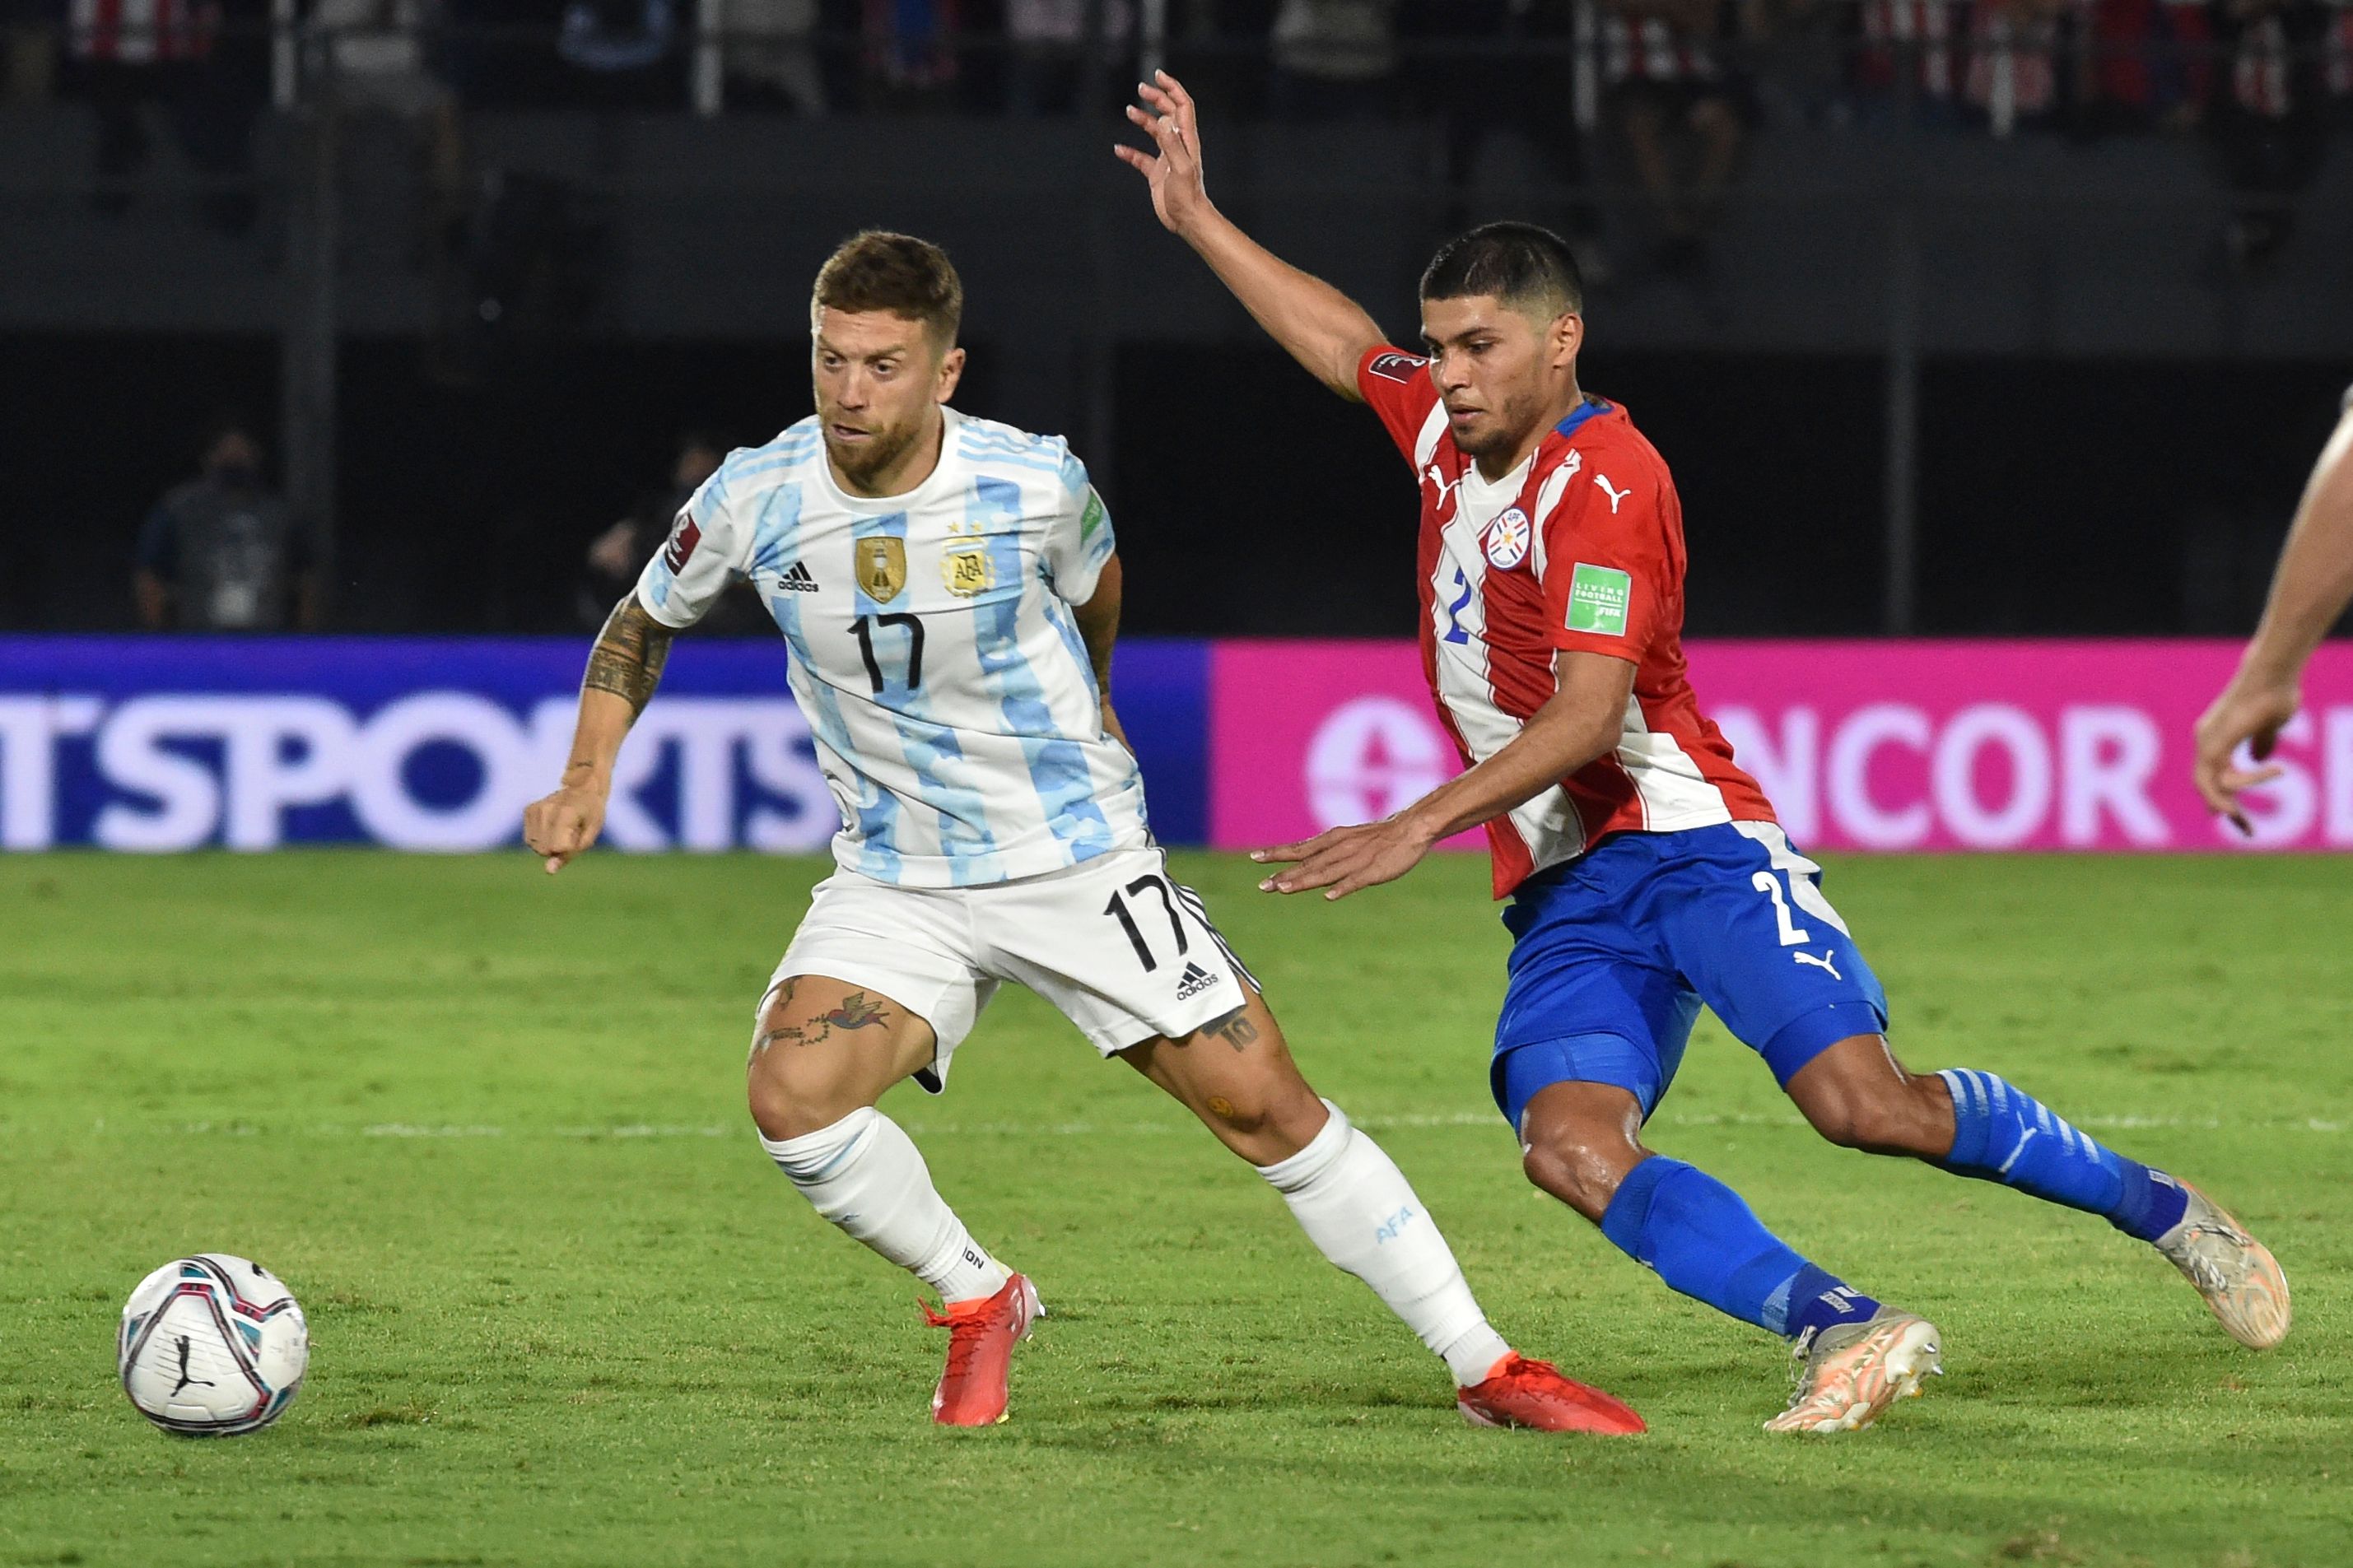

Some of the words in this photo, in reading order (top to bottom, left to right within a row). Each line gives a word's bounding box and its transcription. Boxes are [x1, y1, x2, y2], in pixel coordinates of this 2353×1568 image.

[777, 578, 819, 593] adidas
[1442, 565, 1471, 645] 2
[1575, 589, 1623, 603] FOOTBALL
[1576, 582, 1624, 596] LIVING
[847, 613, 925, 693] 17
[1712, 702, 2169, 850] NCOR
[1103, 874, 1188, 972] 17
[1751, 871, 1810, 947] 2
[1176, 972, 1218, 1001] adidas
[1377, 1207, 1414, 1245] AFA
